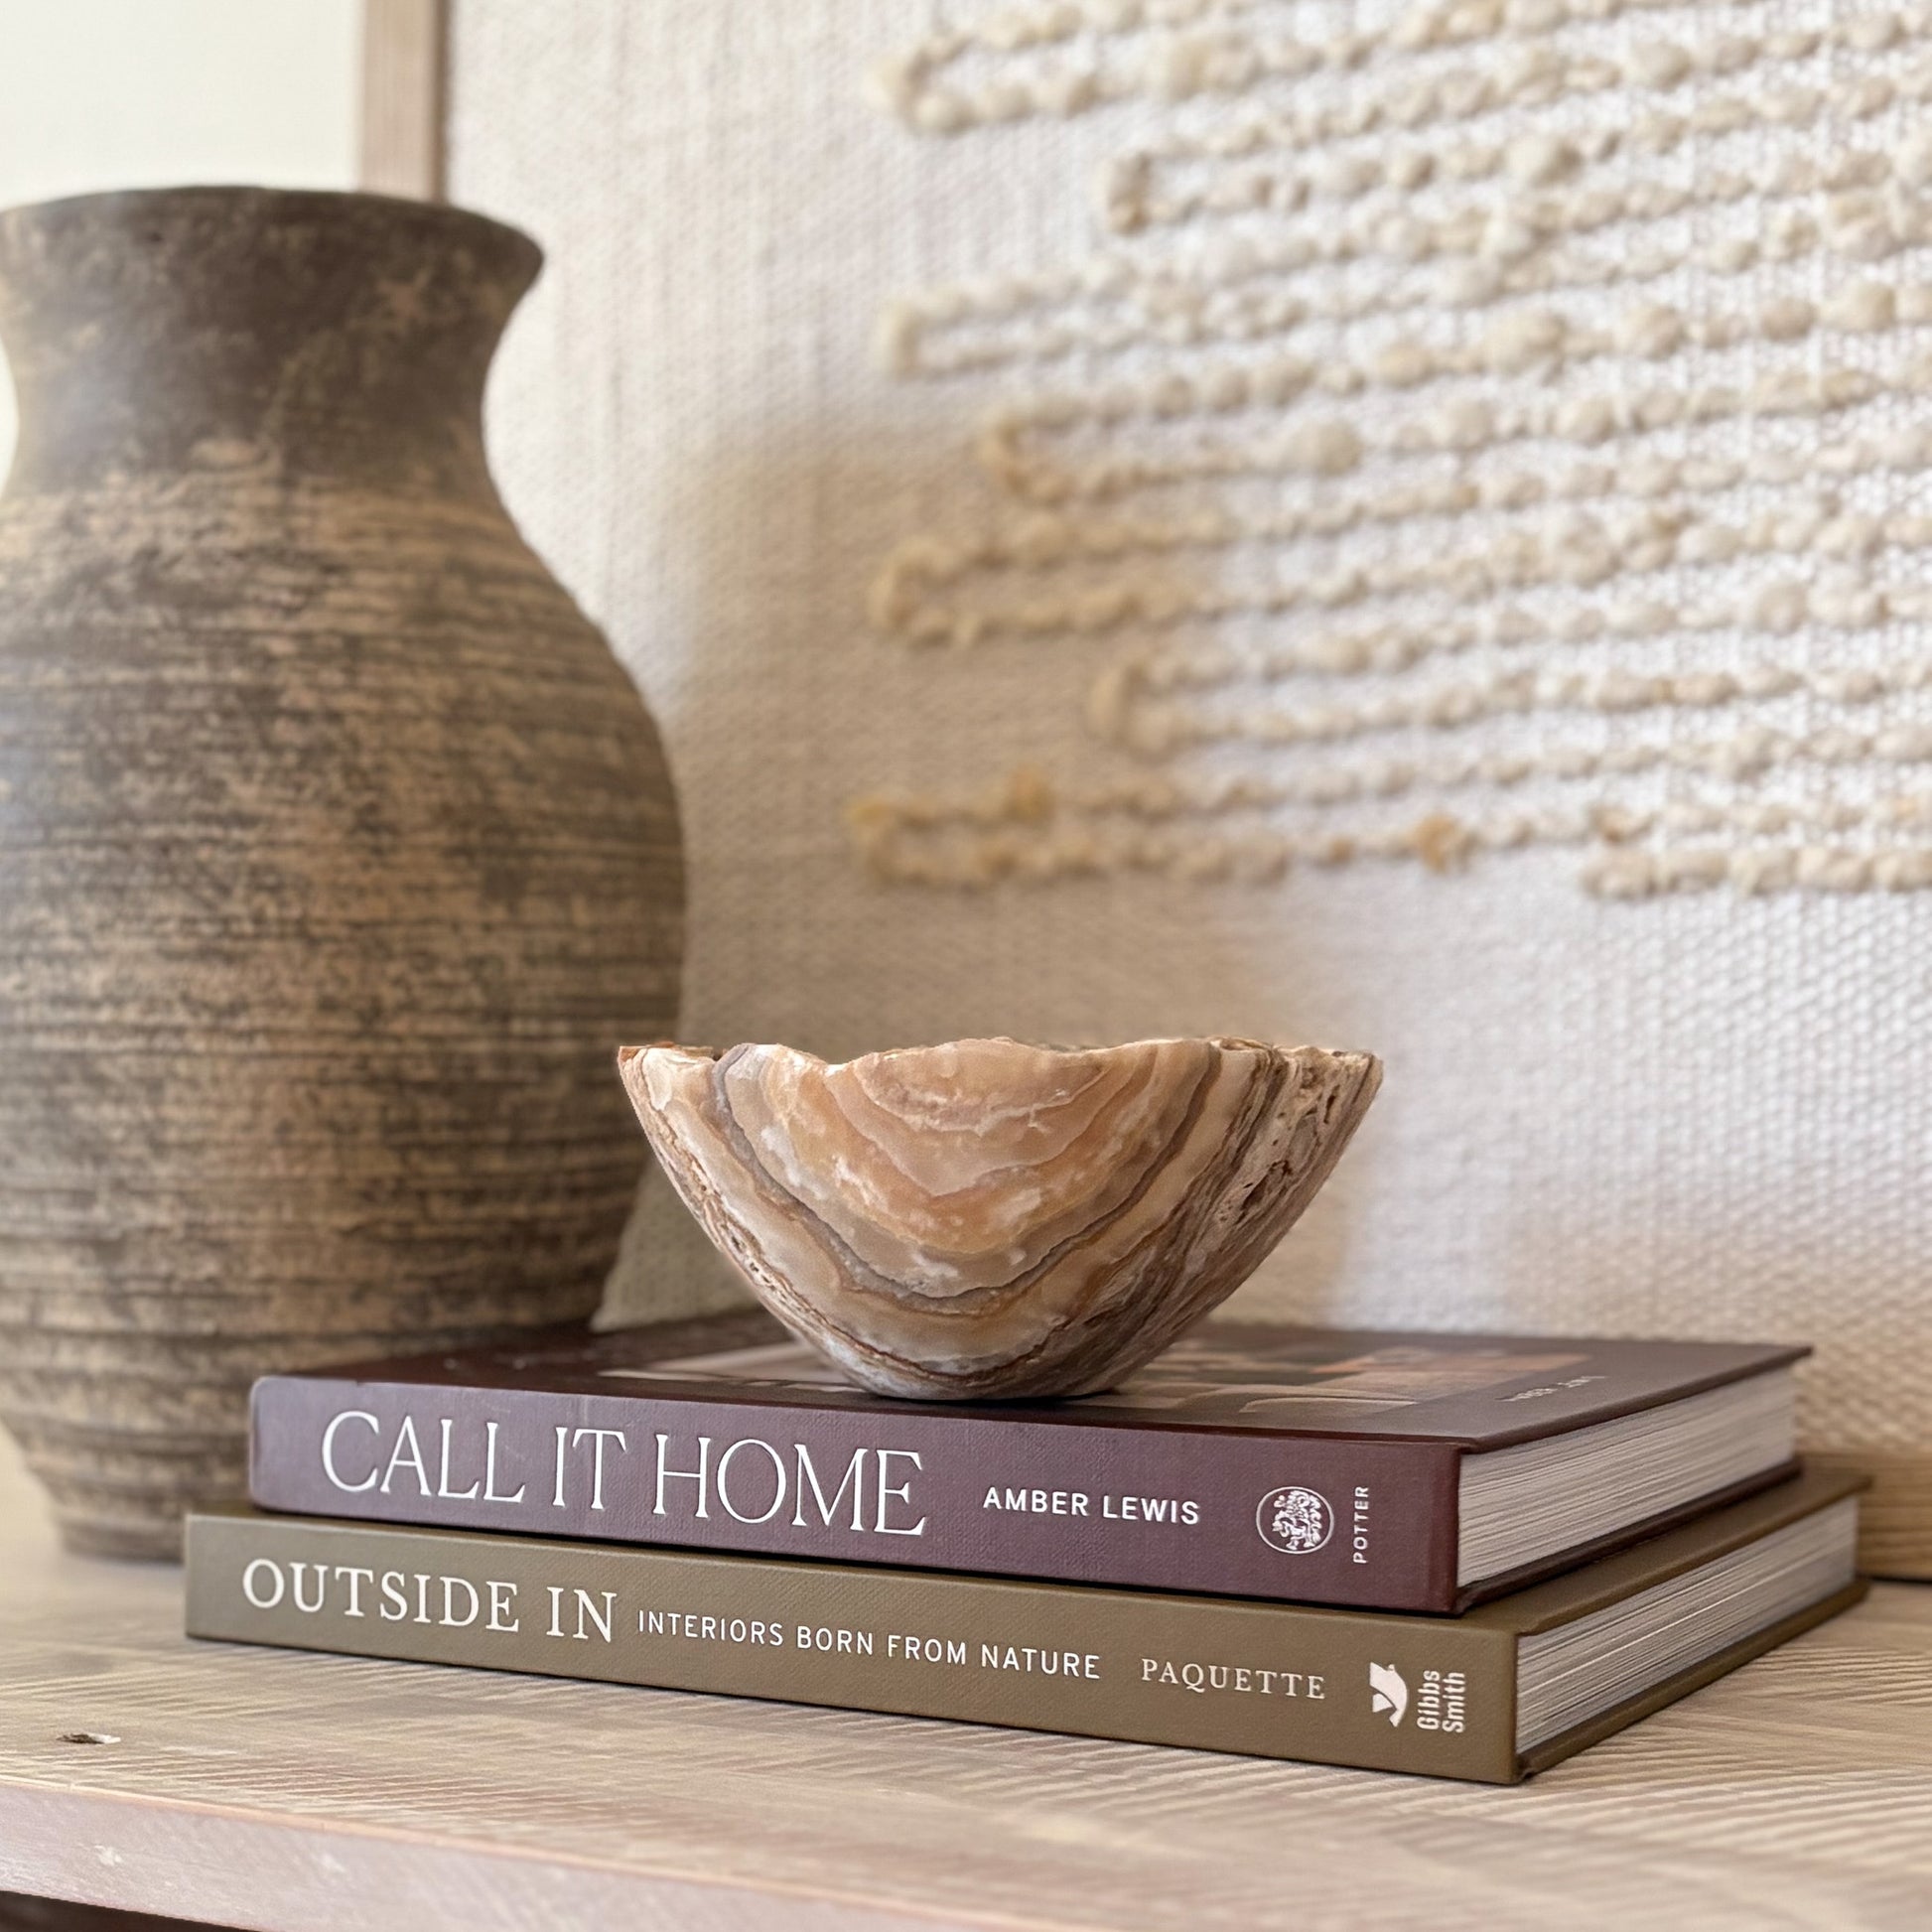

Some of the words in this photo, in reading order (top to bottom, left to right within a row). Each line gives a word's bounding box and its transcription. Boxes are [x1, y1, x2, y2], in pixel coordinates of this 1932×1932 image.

[322, 1411, 525, 1503] CALL
[552, 1427, 627, 1511] IT
[652, 1434, 926, 1536] HOME
[983, 1486, 1089, 1517] AMBER
[1102, 1495, 1200, 1525] LEWIS
[1352, 1486, 1370, 1565] POTTER
[242, 1558, 519, 1633] OUTSIDE
[546, 1587, 618, 1644] IN
[638, 1609, 784, 1647] INTERIORS
[797, 1625, 874, 1656] BORN
[888, 1634, 967, 1665] FROM
[981, 1643, 1101, 1680] NATURE
[1141, 1658, 1326, 1700] PAQUETTE
[1416, 1670, 1441, 1731] Gibbs
[1442, 1672, 1466, 1733] Smith
